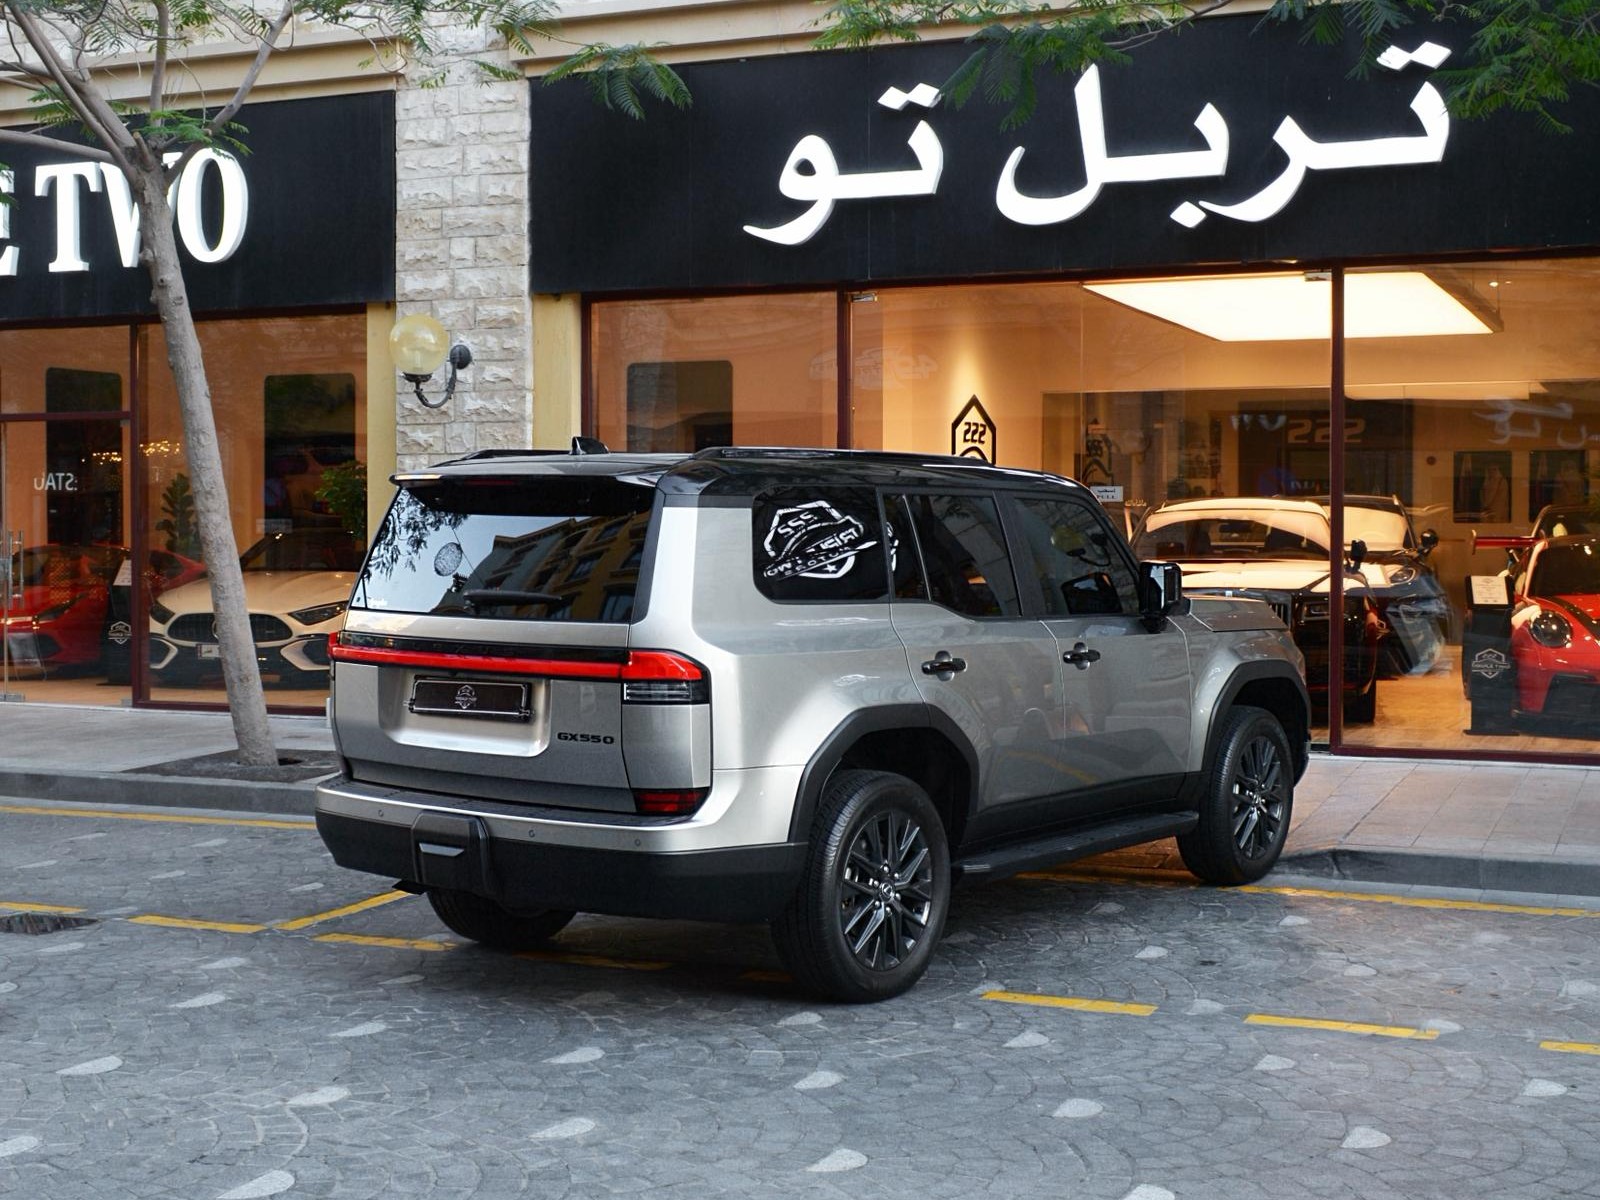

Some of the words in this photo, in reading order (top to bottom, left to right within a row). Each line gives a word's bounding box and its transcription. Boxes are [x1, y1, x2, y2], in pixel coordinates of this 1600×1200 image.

[742, 82, 942, 245] تو
[995, 42, 1450, 228] تربل
[963, 421, 987, 445] 222
[557, 732, 615, 744] GX550
